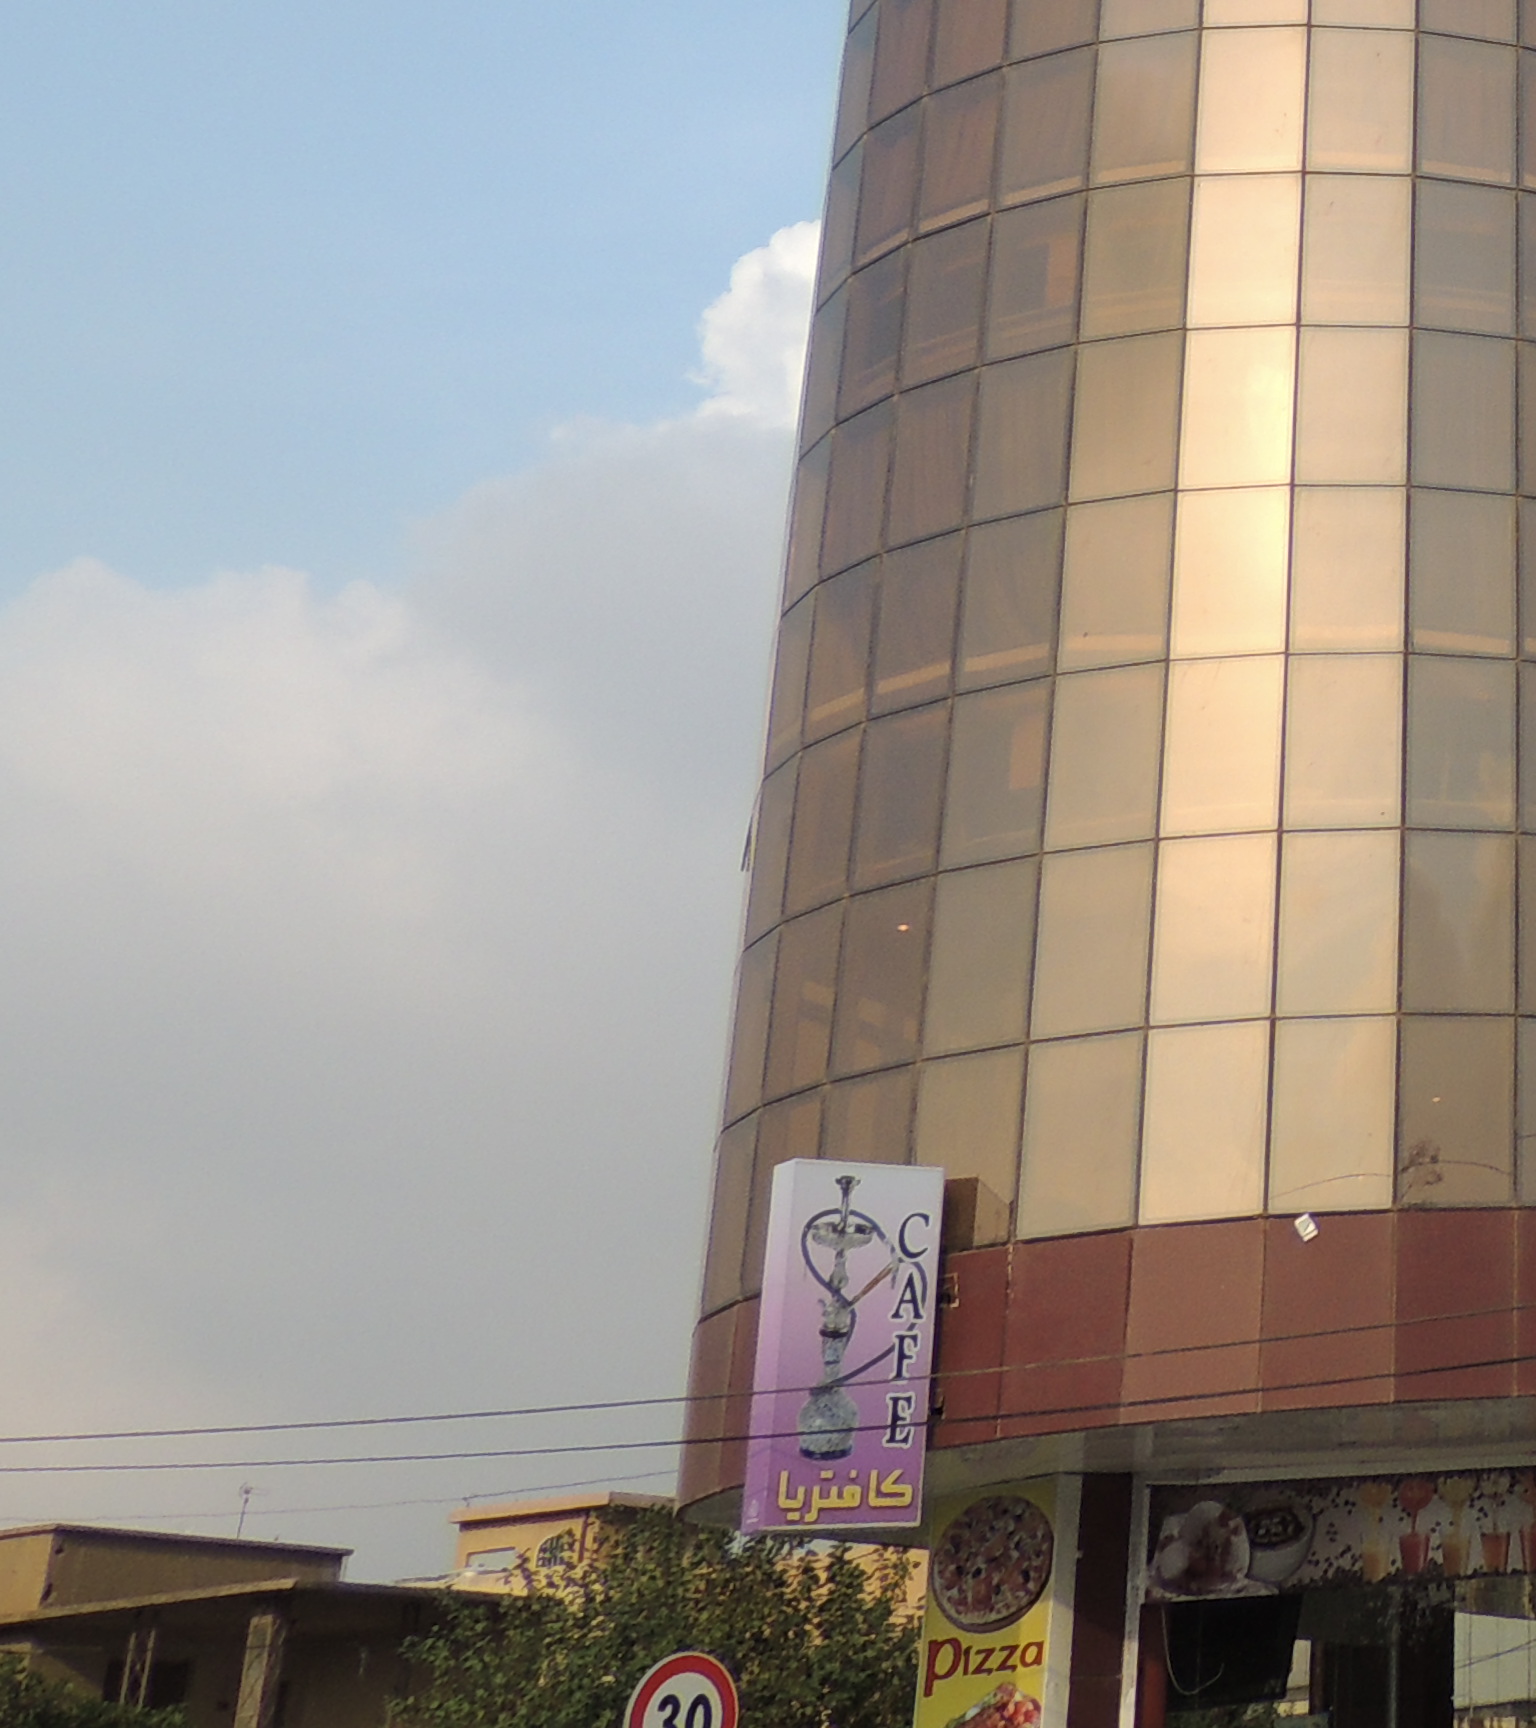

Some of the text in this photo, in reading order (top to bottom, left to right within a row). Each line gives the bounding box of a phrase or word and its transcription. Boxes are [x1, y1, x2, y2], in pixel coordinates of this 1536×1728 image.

[884, 1211, 930, 1449] CAFE
[778, 1469, 913, 1522] كافتريا
[657, 1693, 713, 1728] 30
